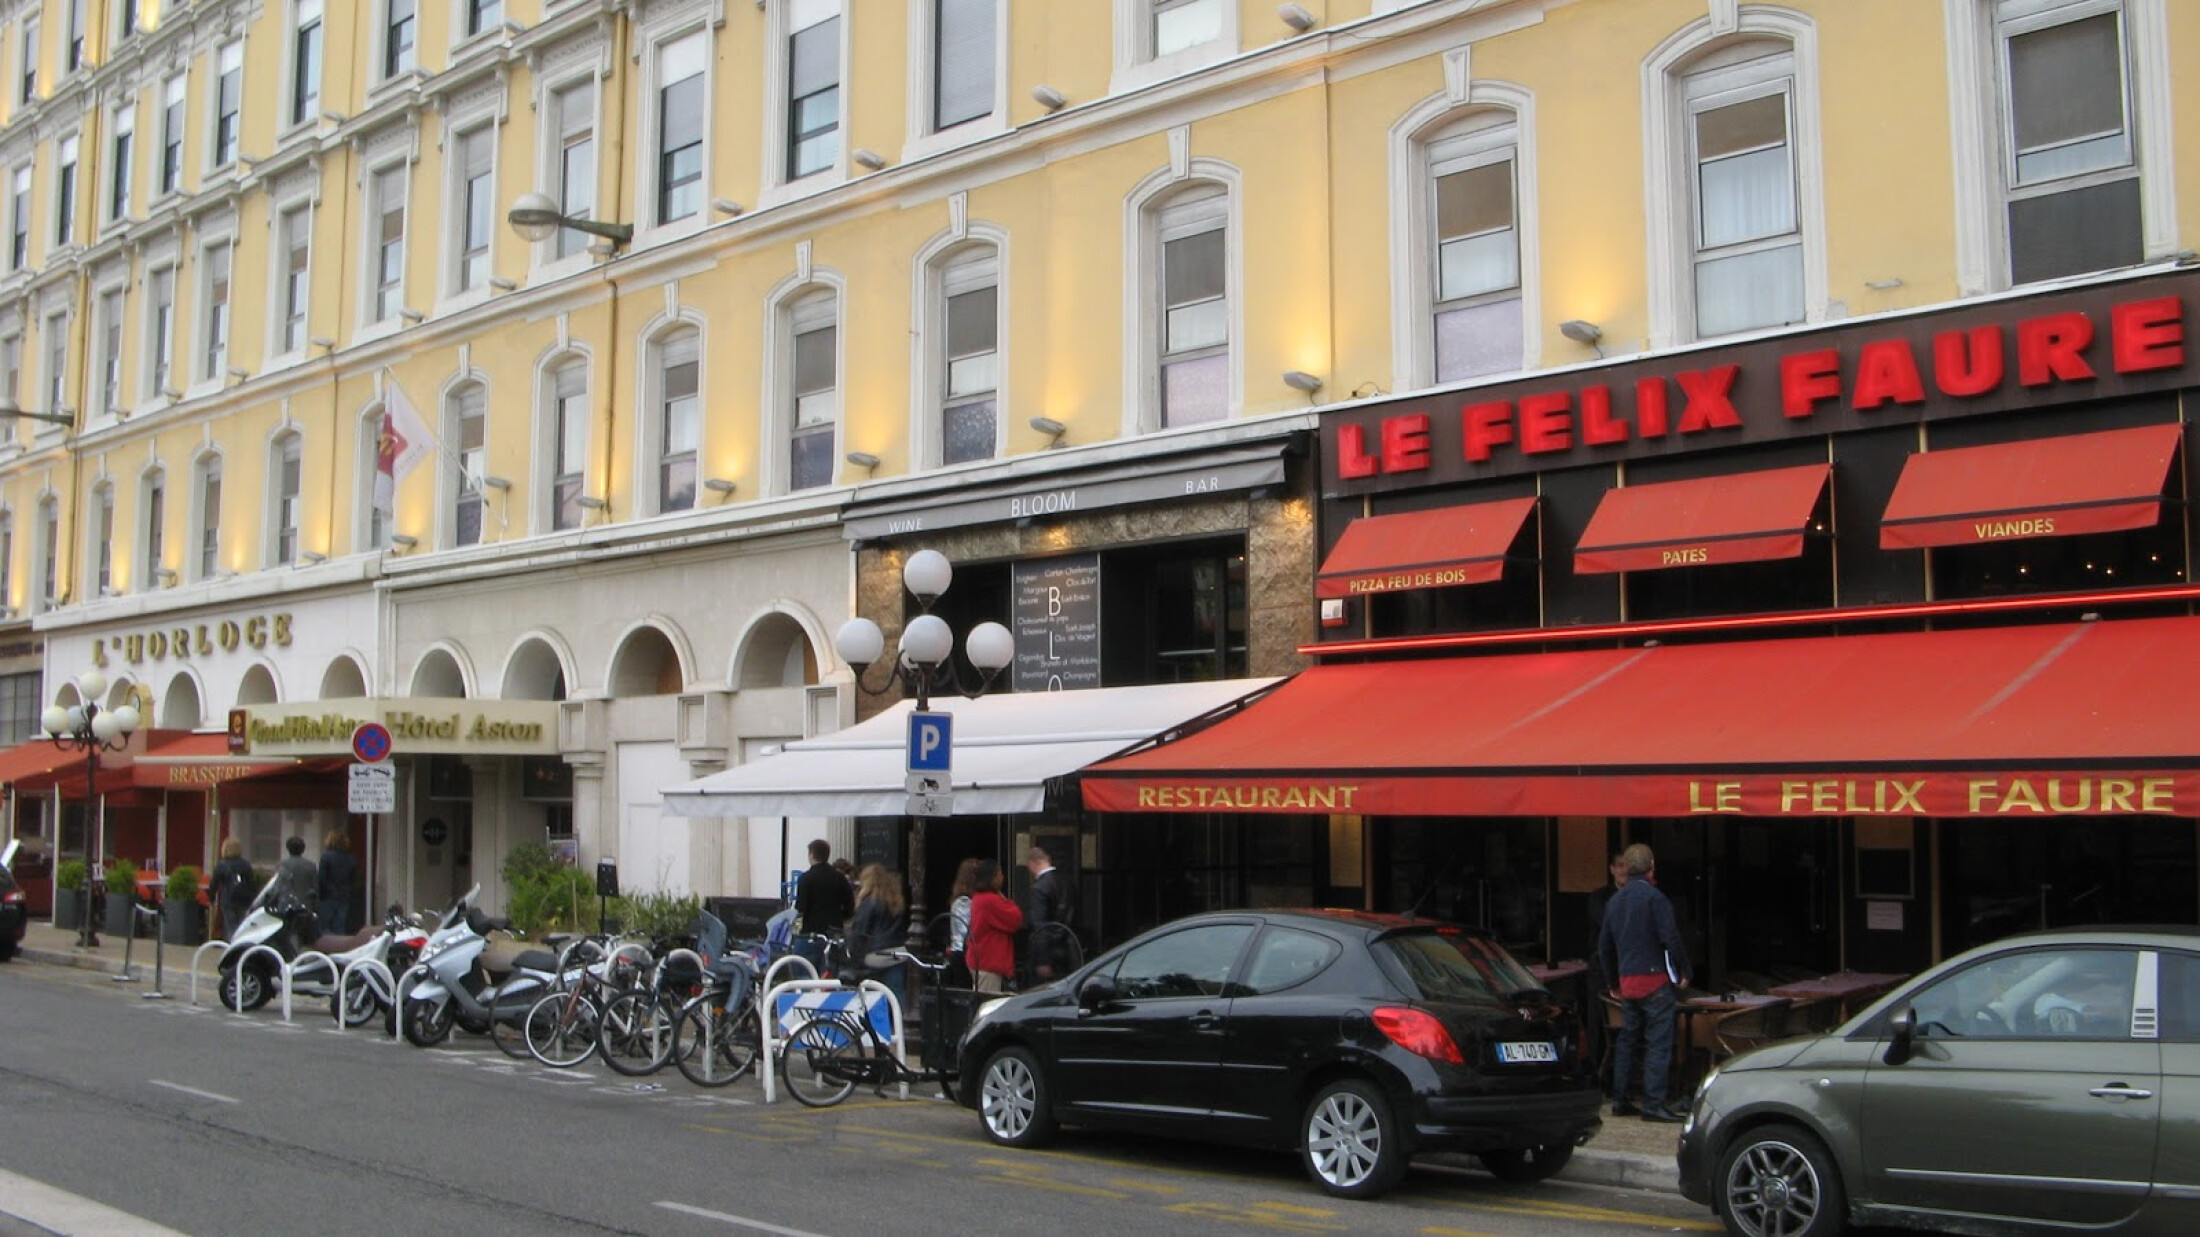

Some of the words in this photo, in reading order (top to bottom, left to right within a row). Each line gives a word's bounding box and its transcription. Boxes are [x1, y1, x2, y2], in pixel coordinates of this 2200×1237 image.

[1338, 414, 1430, 479] LE
[1463, 364, 1743, 462] FELIX
[1780, 296, 2185, 418] FAURE
[889, 518, 922, 533] WINE
[1185, 476, 1219, 494] BAR
[1011, 491, 1076, 518] BLOOM
[1975, 517, 2054, 539] VIANDES
[1663, 547, 1707, 565] PATES
[1349, 578, 1384, 593] PIZZA
[1388, 575, 1412, 589] FEU
[1415, 573, 1432, 586] DE
[1436, 568, 1467, 584] BOIS
[93, 613, 293, 667] L'HORLOGE
[385, 711, 461, 740] Hôtel
[466, 713, 543, 742] Aston
[920, 724, 940, 761] P
[1139, 785, 1358, 808] RESTAURANT
[1690, 781, 1742, 812] LE
[1781, 780, 1926, 813] FELIX
[1969, 778, 2175, 813] FAURE
